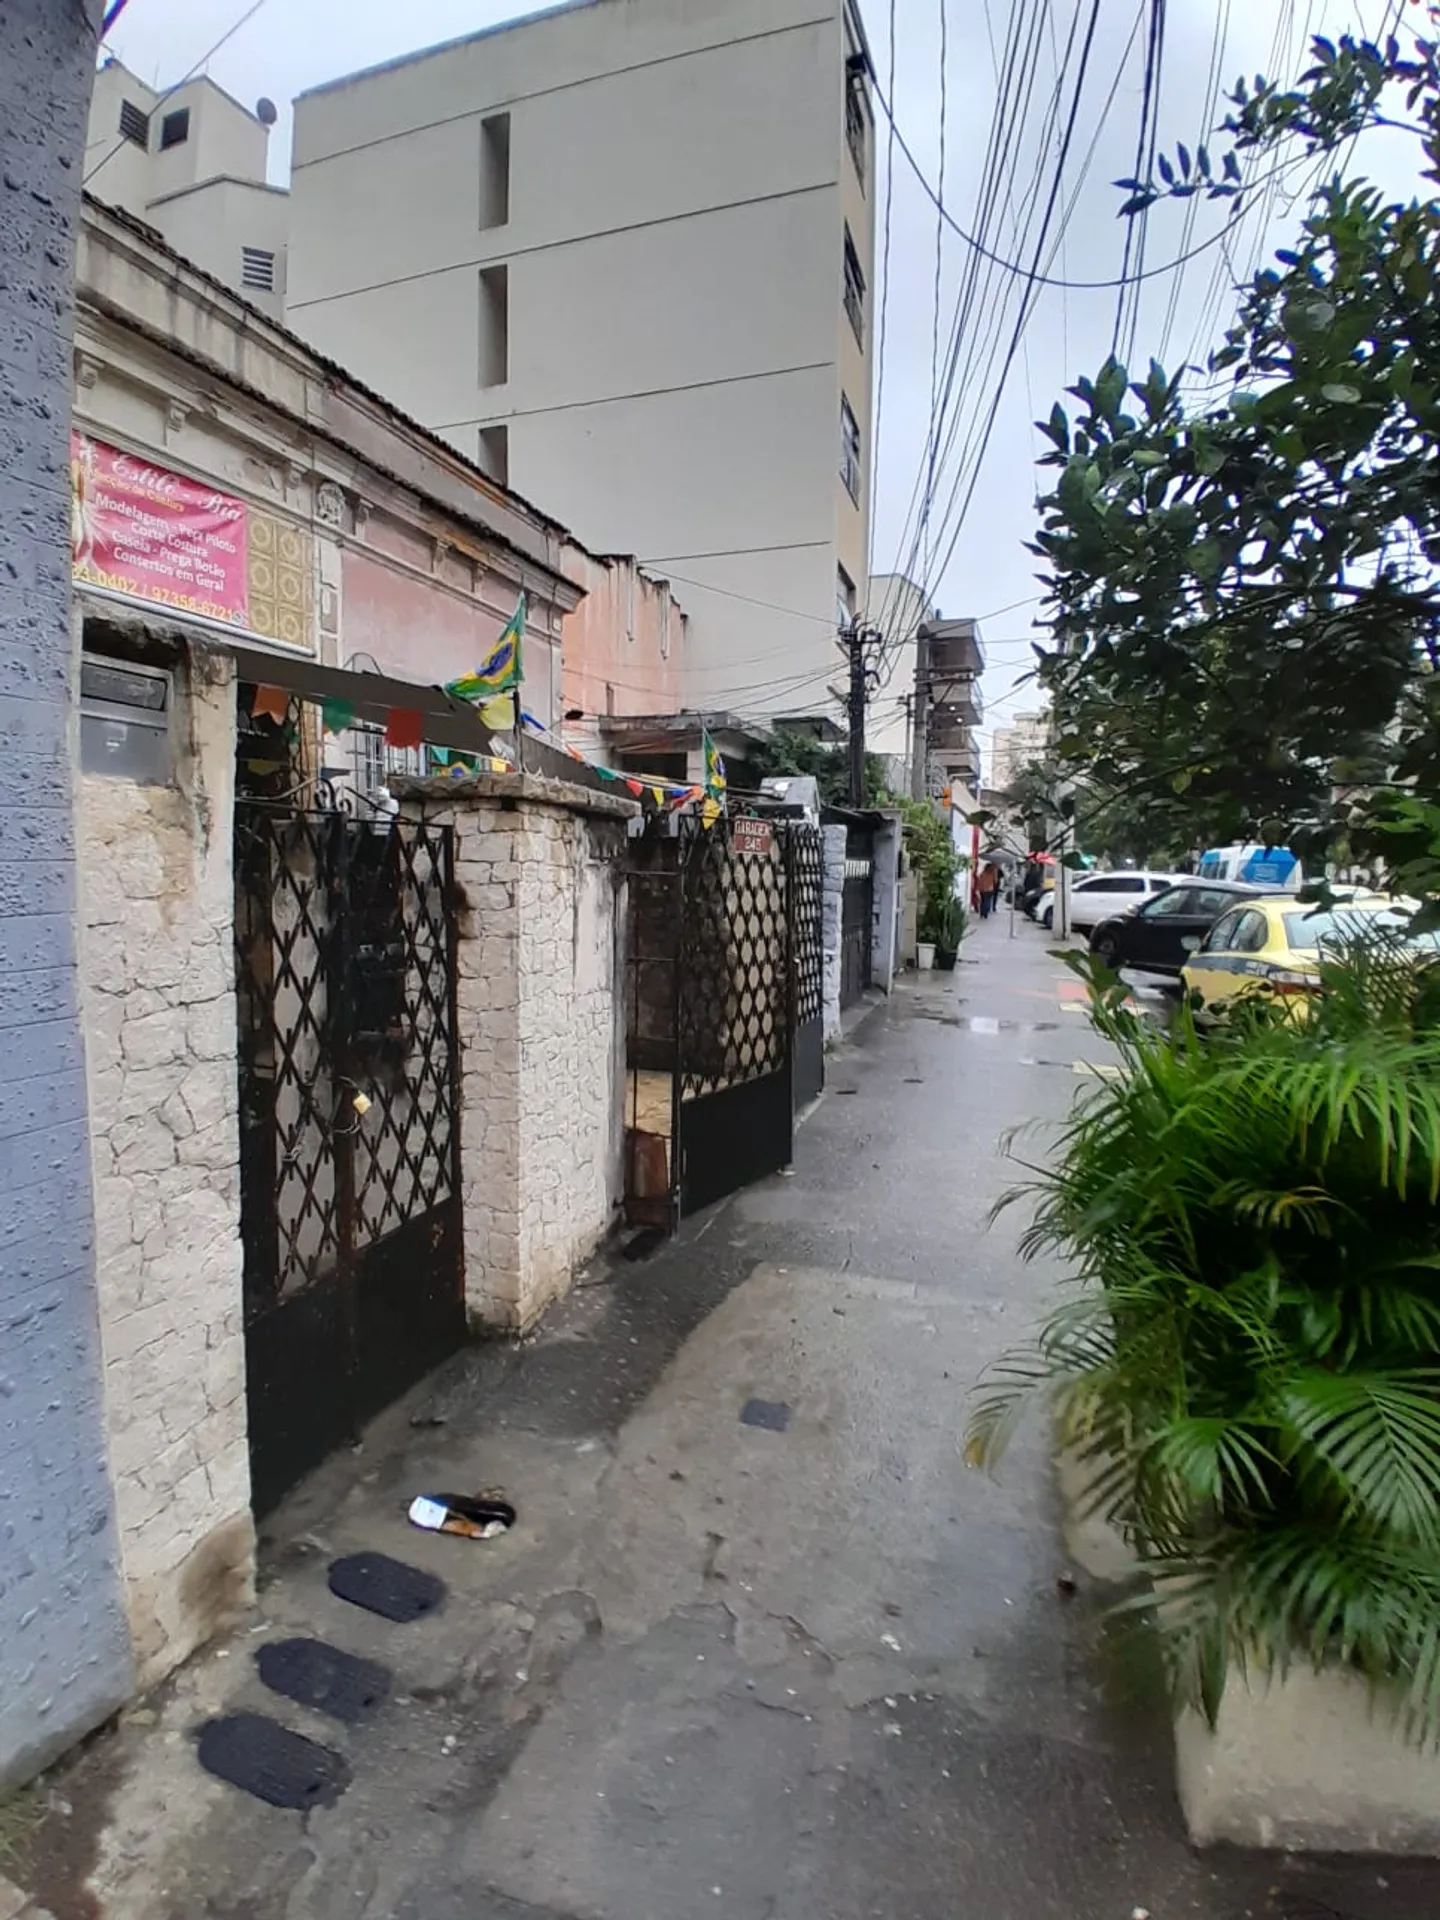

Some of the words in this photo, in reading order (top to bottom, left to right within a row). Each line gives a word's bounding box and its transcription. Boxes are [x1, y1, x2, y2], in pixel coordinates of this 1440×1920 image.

[95, 492, 170, 534] Modelagem
[167, 533, 208, 557] Costura
[113, 546, 174, 576] Consertos
[174, 569, 195, 583] em
[195, 573, 225, 592] Geral
